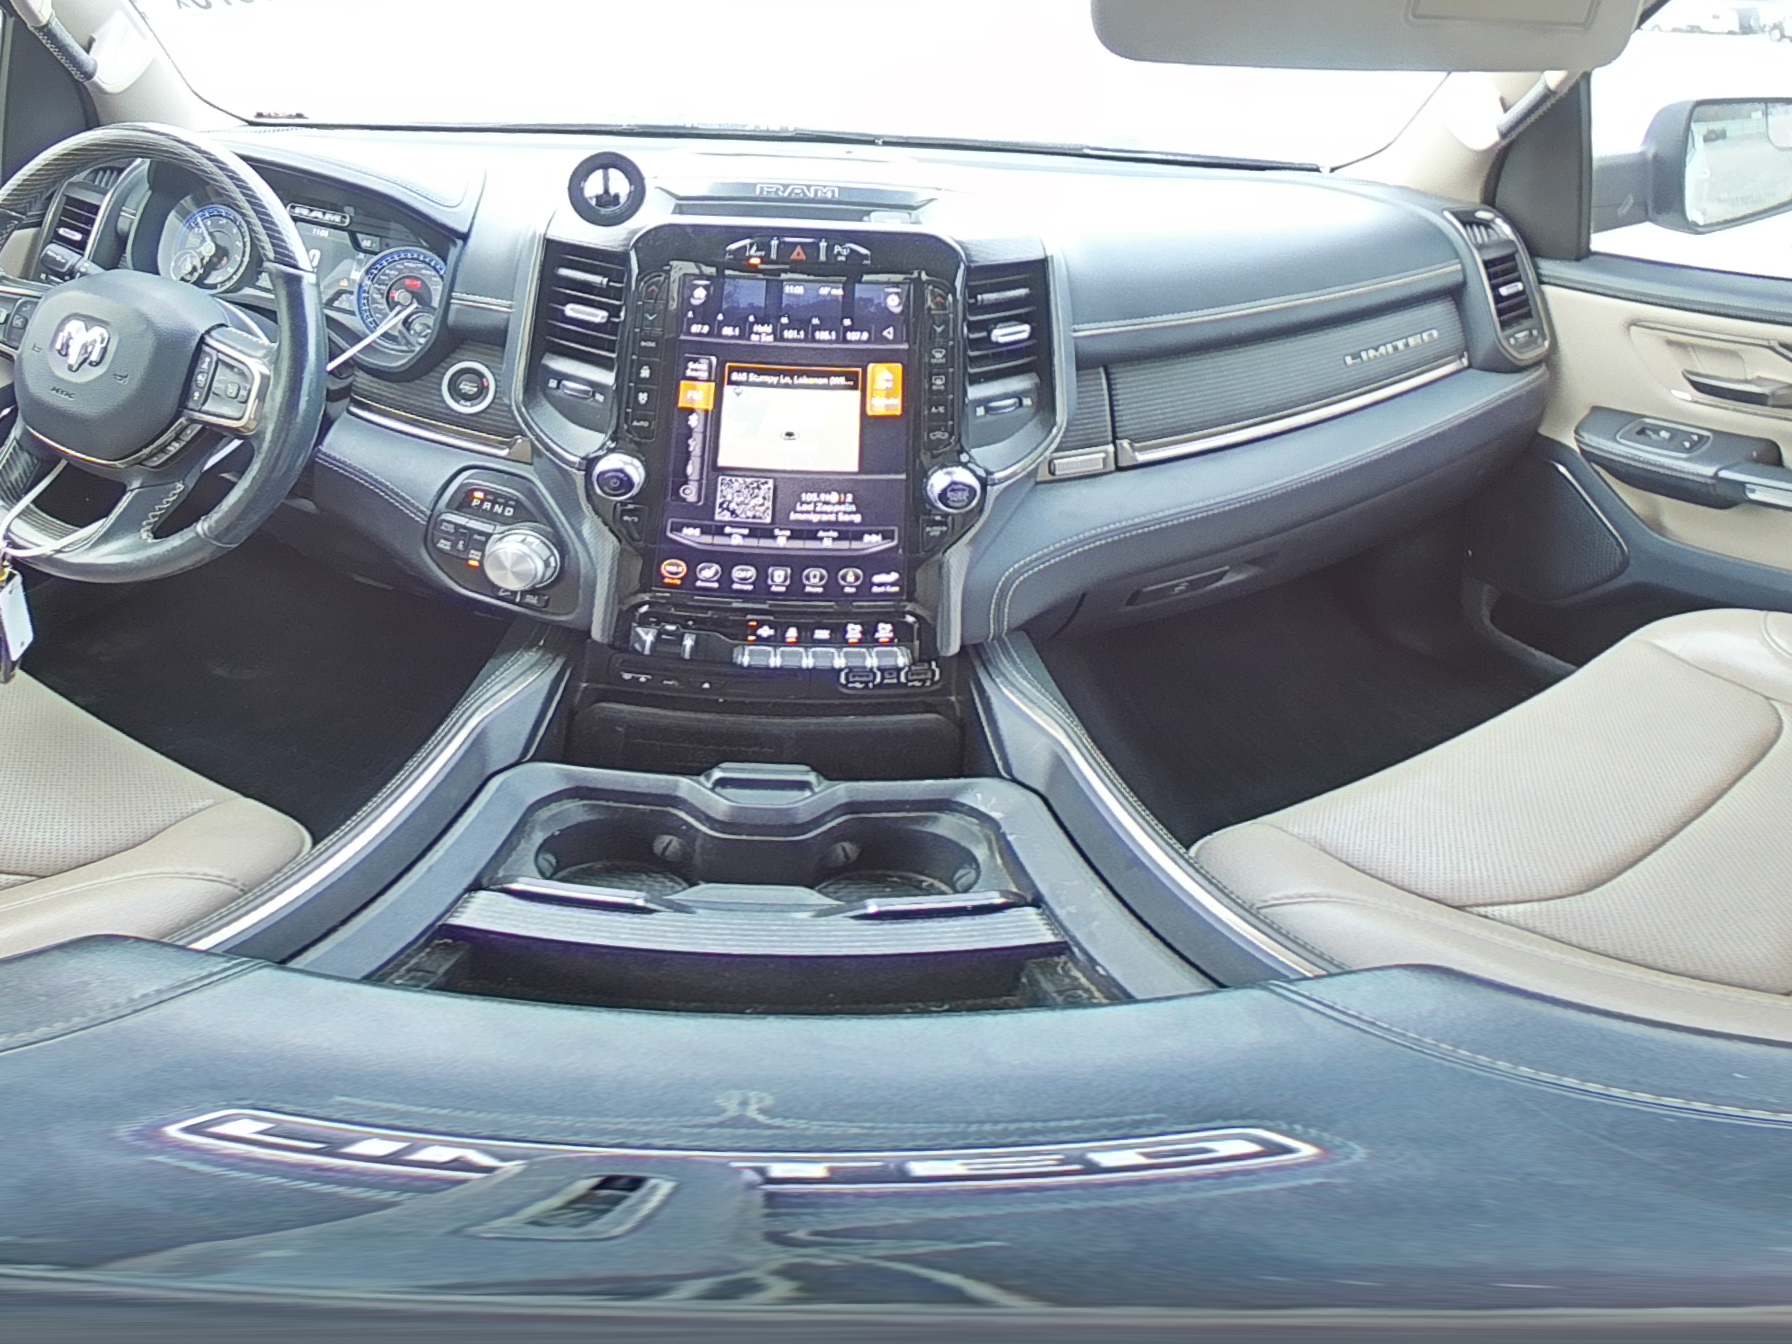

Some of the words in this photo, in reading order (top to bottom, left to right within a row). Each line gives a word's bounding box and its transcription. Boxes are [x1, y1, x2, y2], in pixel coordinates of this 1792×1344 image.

[756, 184, 839, 199] RAM
[294, 206, 343, 224] RAM
[1343, 329, 1439, 367] LIMITED
[471, 498, 481, 507] P
[482, 501, 492, 511] R
[493, 504, 503, 514] N
[504, 506, 515, 516] D
[796, 502, 815, 512] Led
